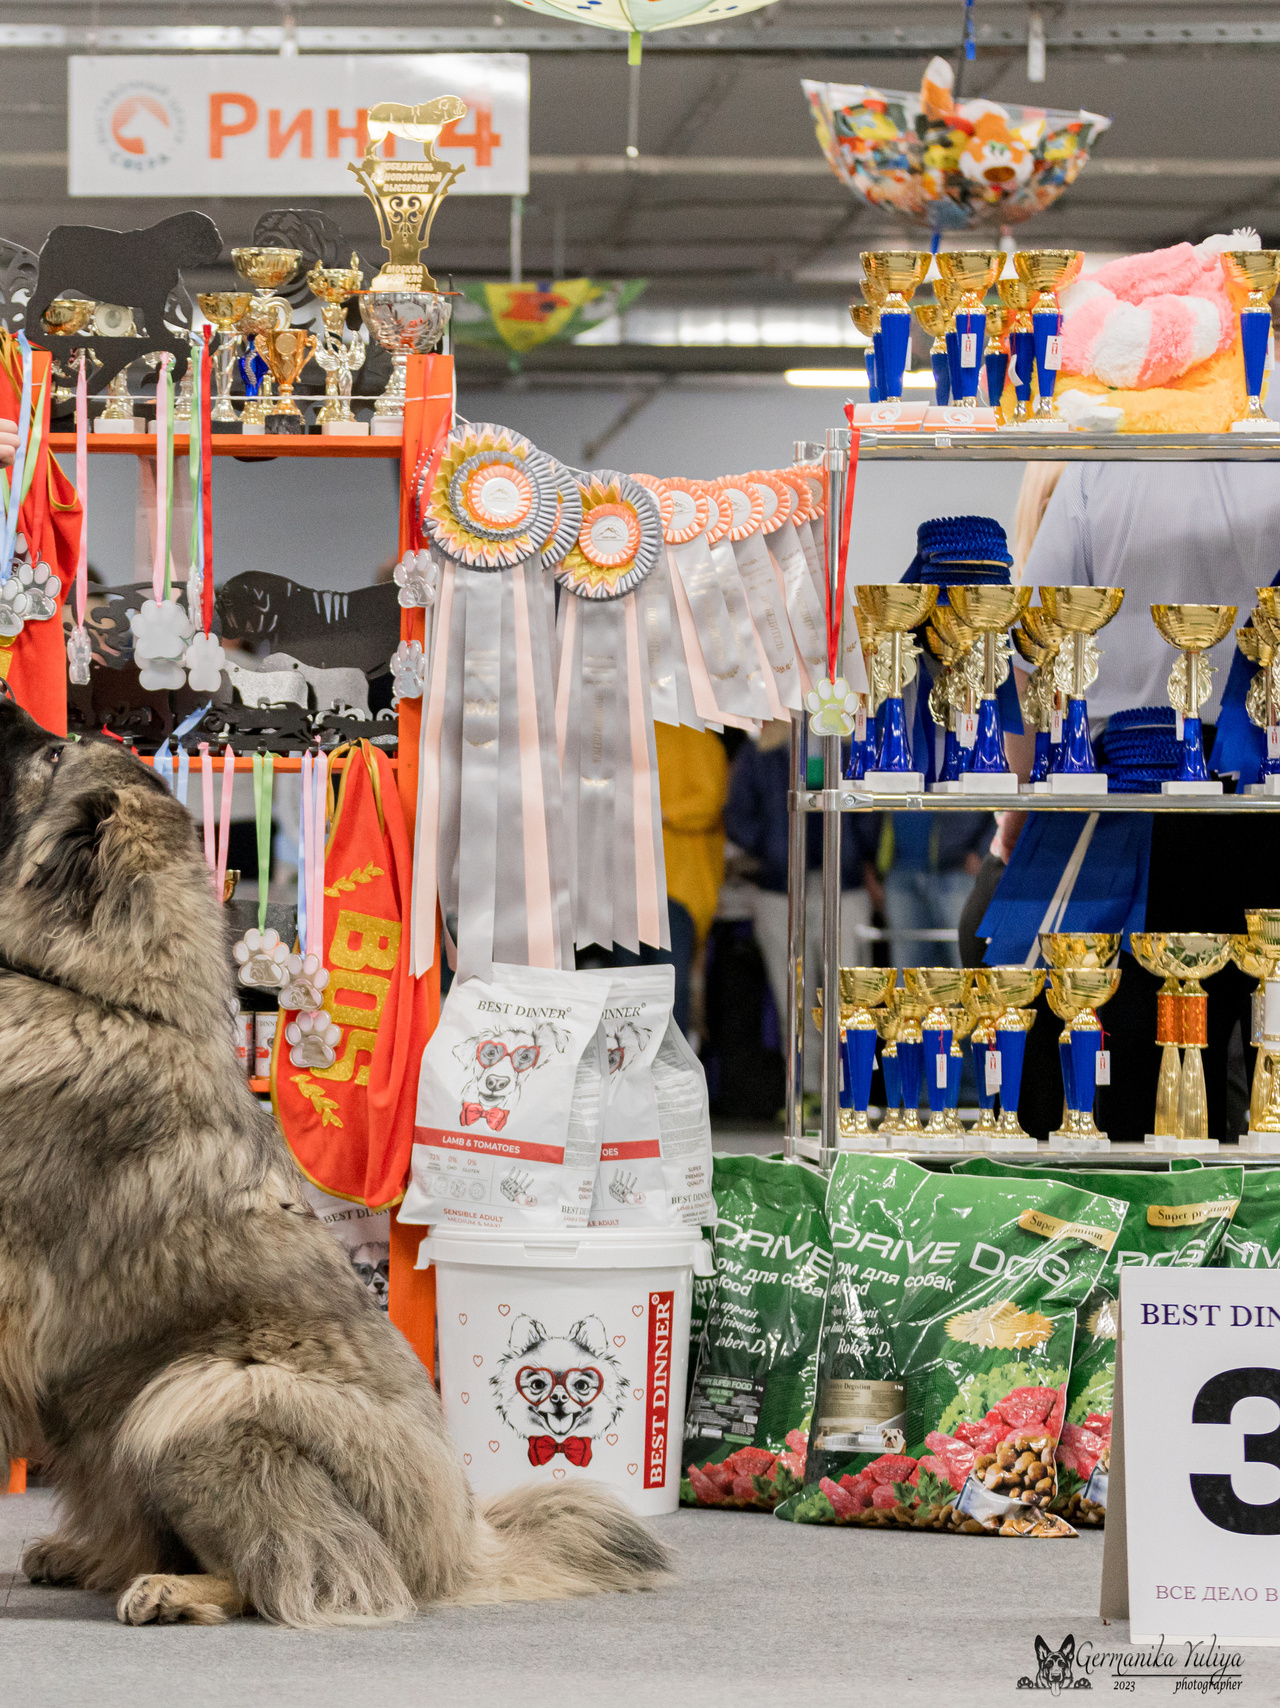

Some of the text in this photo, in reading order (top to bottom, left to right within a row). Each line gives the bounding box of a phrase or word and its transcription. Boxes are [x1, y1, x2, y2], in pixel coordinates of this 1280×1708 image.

[438, 92, 501, 167] 4
[310, 908, 402, 1086] BOS
[476, 1000, 567, 1020] BEST DINNER
[442, 1135, 521, 1154] LAMB & TOMATOES
[448, 1155, 458, 1163] 0%
[467, 1158, 478, 1167] 0%
[685, 1172, 705, 1180] PREMIUM
[687, 1179, 705, 1187] QUALITY
[671, 1194, 692, 1205] BEST
[324, 1208, 355, 1224] BEST
[443, 1208, 504, 1223] SENSIBLE ADULT
[598, 1219, 620, 1227] ADULT
[1029, 1214, 1057, 1233] Super
[1158, 1209, 1188, 1223] Super
[714, 1218, 833, 1278] DRIVE
[831, 1222, 1070, 1287] DRIVE DOG
[719, 1274, 753, 1297] food
[742, 1269, 779, 1284] для
[860, 1267, 900, 1286] для
[904, 1271, 957, 1293] собак
[721, 1301, 759, 1319] appetit
[843, 1306, 879, 1320] aetit
[1141, 1303, 1220, 1327] BEST
[843, 1321, 884, 1336] frinds»
[837, 1338, 892, 1358] Rober D.
[650, 1300, 671, 1485] BEST DINNER
[713, 1379, 753, 1391] SUPER FOOD
[1189, 1366, 1280, 1536] 3
[1155, 1585, 1279, 1603] ВСЕ ДЕЛО В
